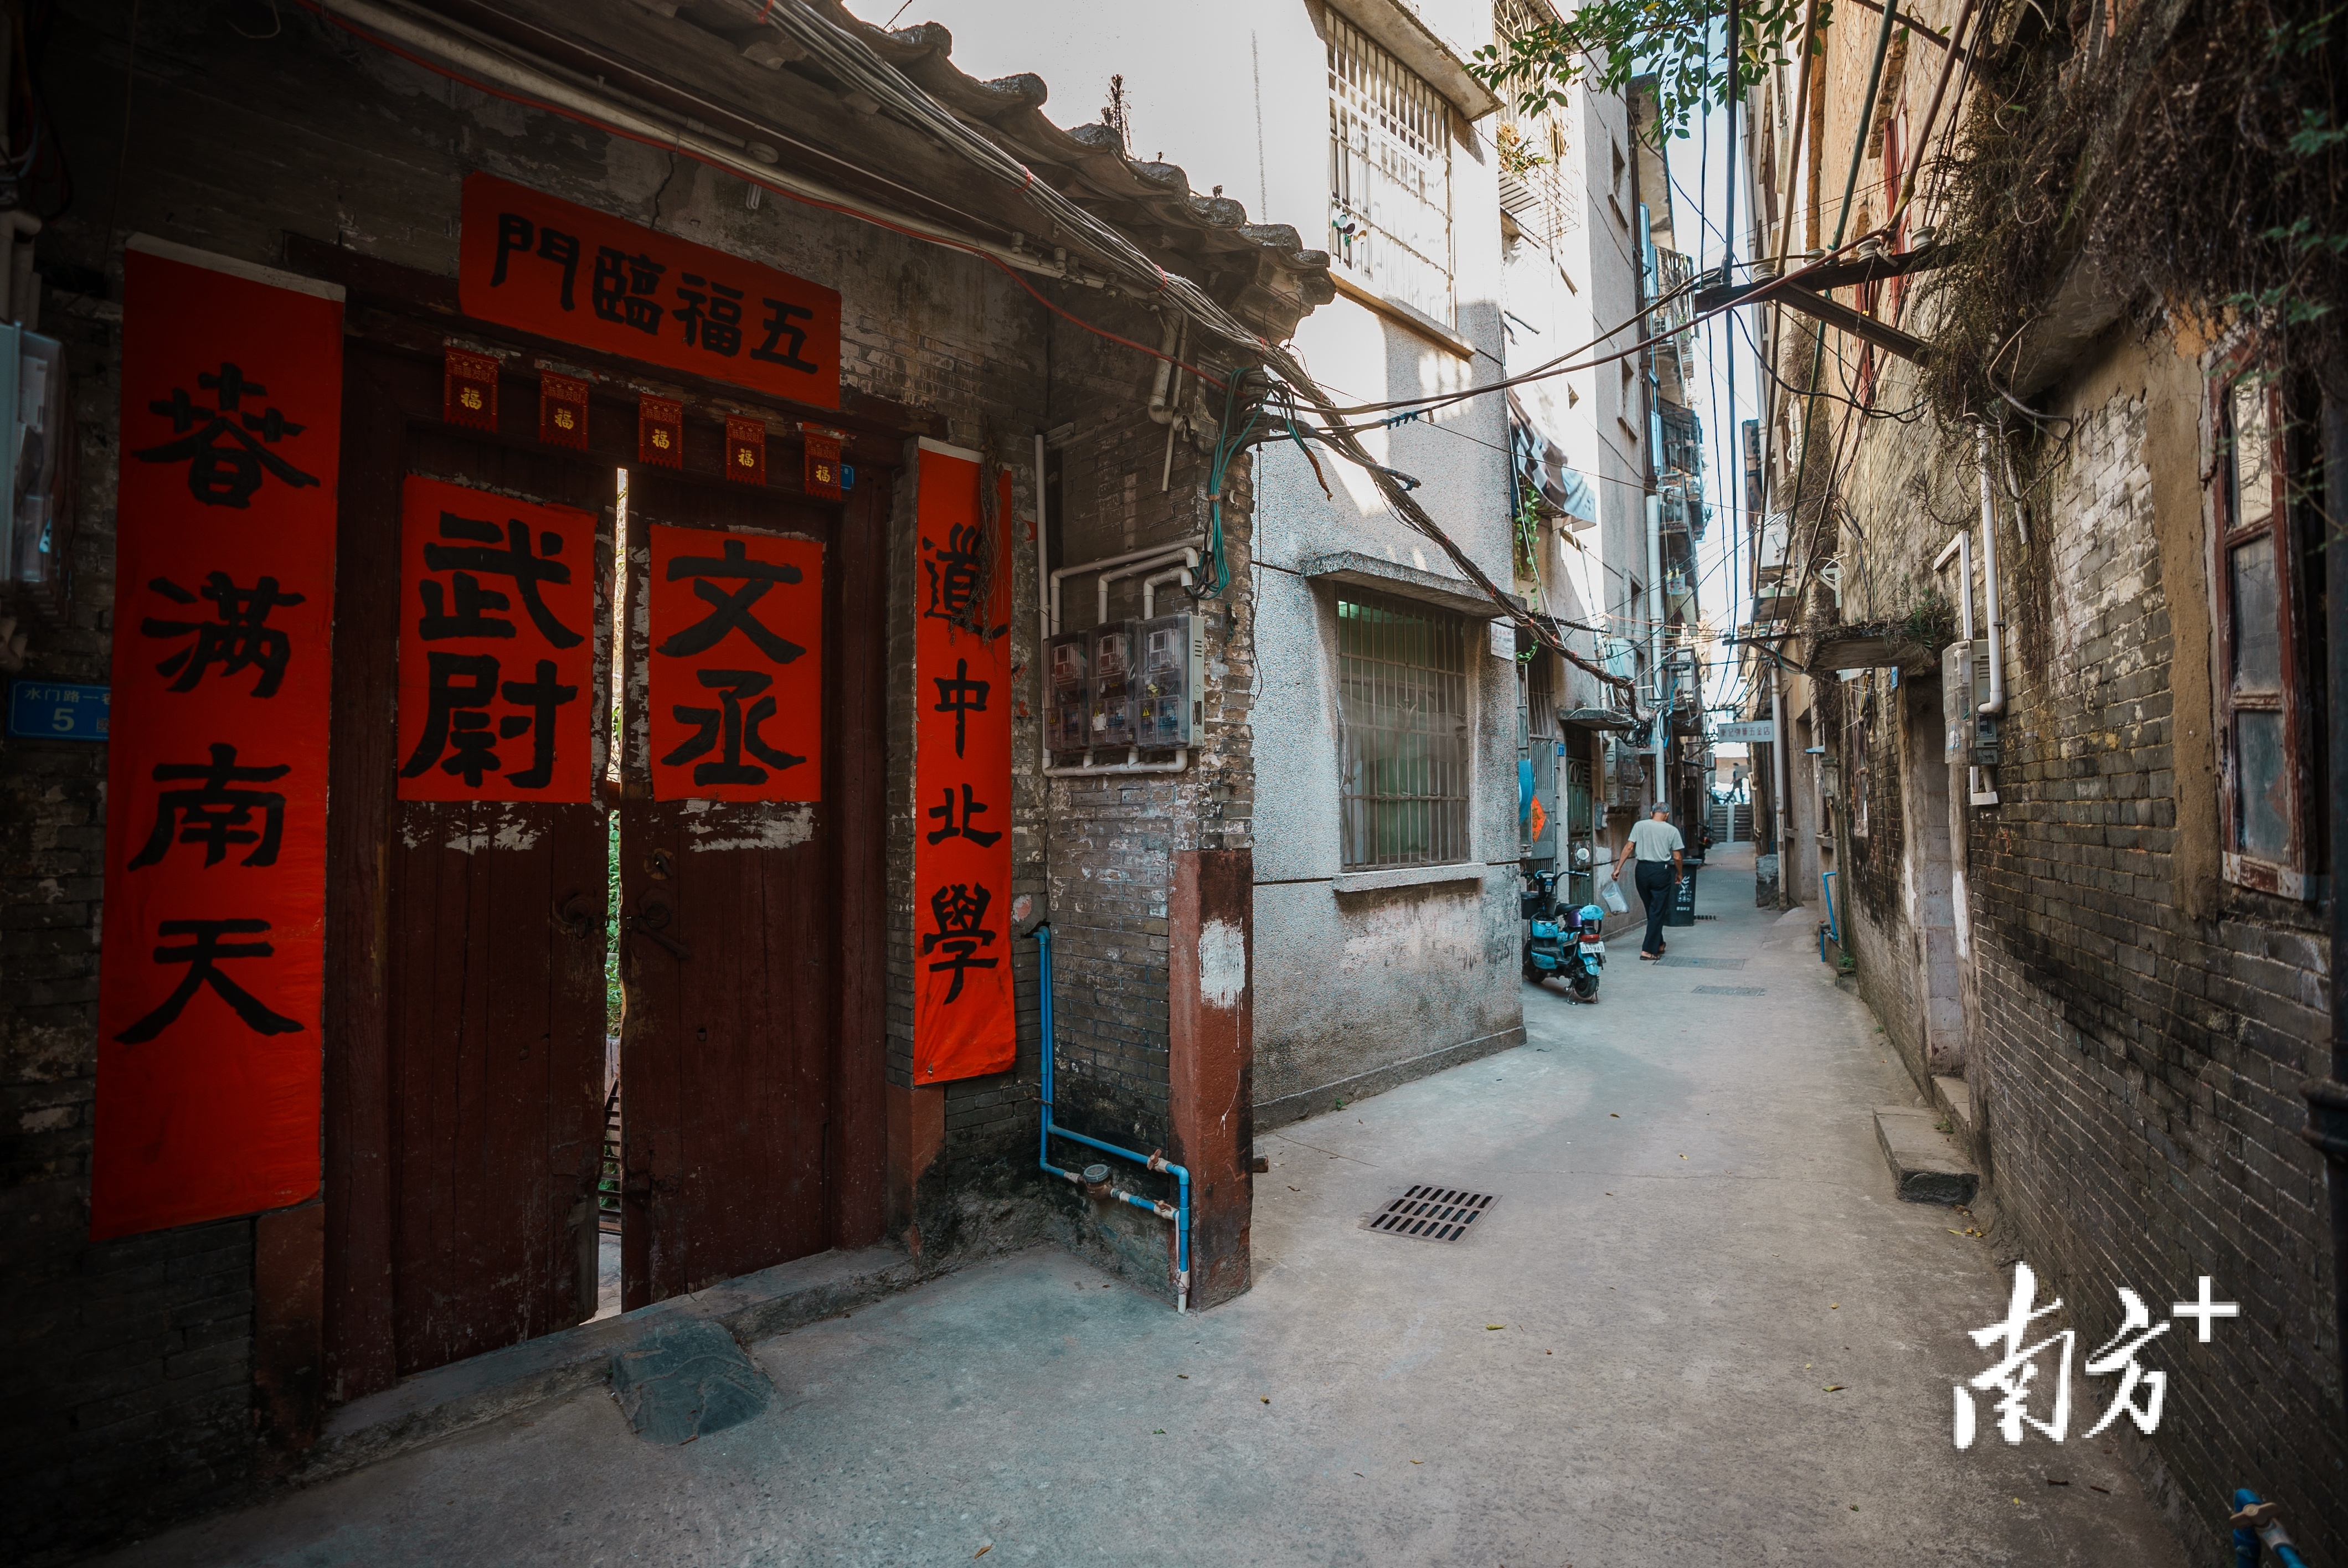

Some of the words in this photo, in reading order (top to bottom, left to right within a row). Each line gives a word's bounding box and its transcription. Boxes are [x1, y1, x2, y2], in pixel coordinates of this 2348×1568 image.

[453, 364, 490, 383] 恭喜发财
[460, 386, 482, 410] 福
[547, 386, 581, 404] 恭喜发财
[554, 407, 574, 430] 福
[645, 408, 676, 424] 恭喜发财
[652, 428, 670, 449] 福
[732, 429, 759, 443] 恭喜发财
[738, 448, 754, 467] 福
[816, 465, 831, 483] 福
[399, 510, 585, 788] 武尉
[656, 539, 807, 787] 文丞
[52, 707, 75, 731] 5
